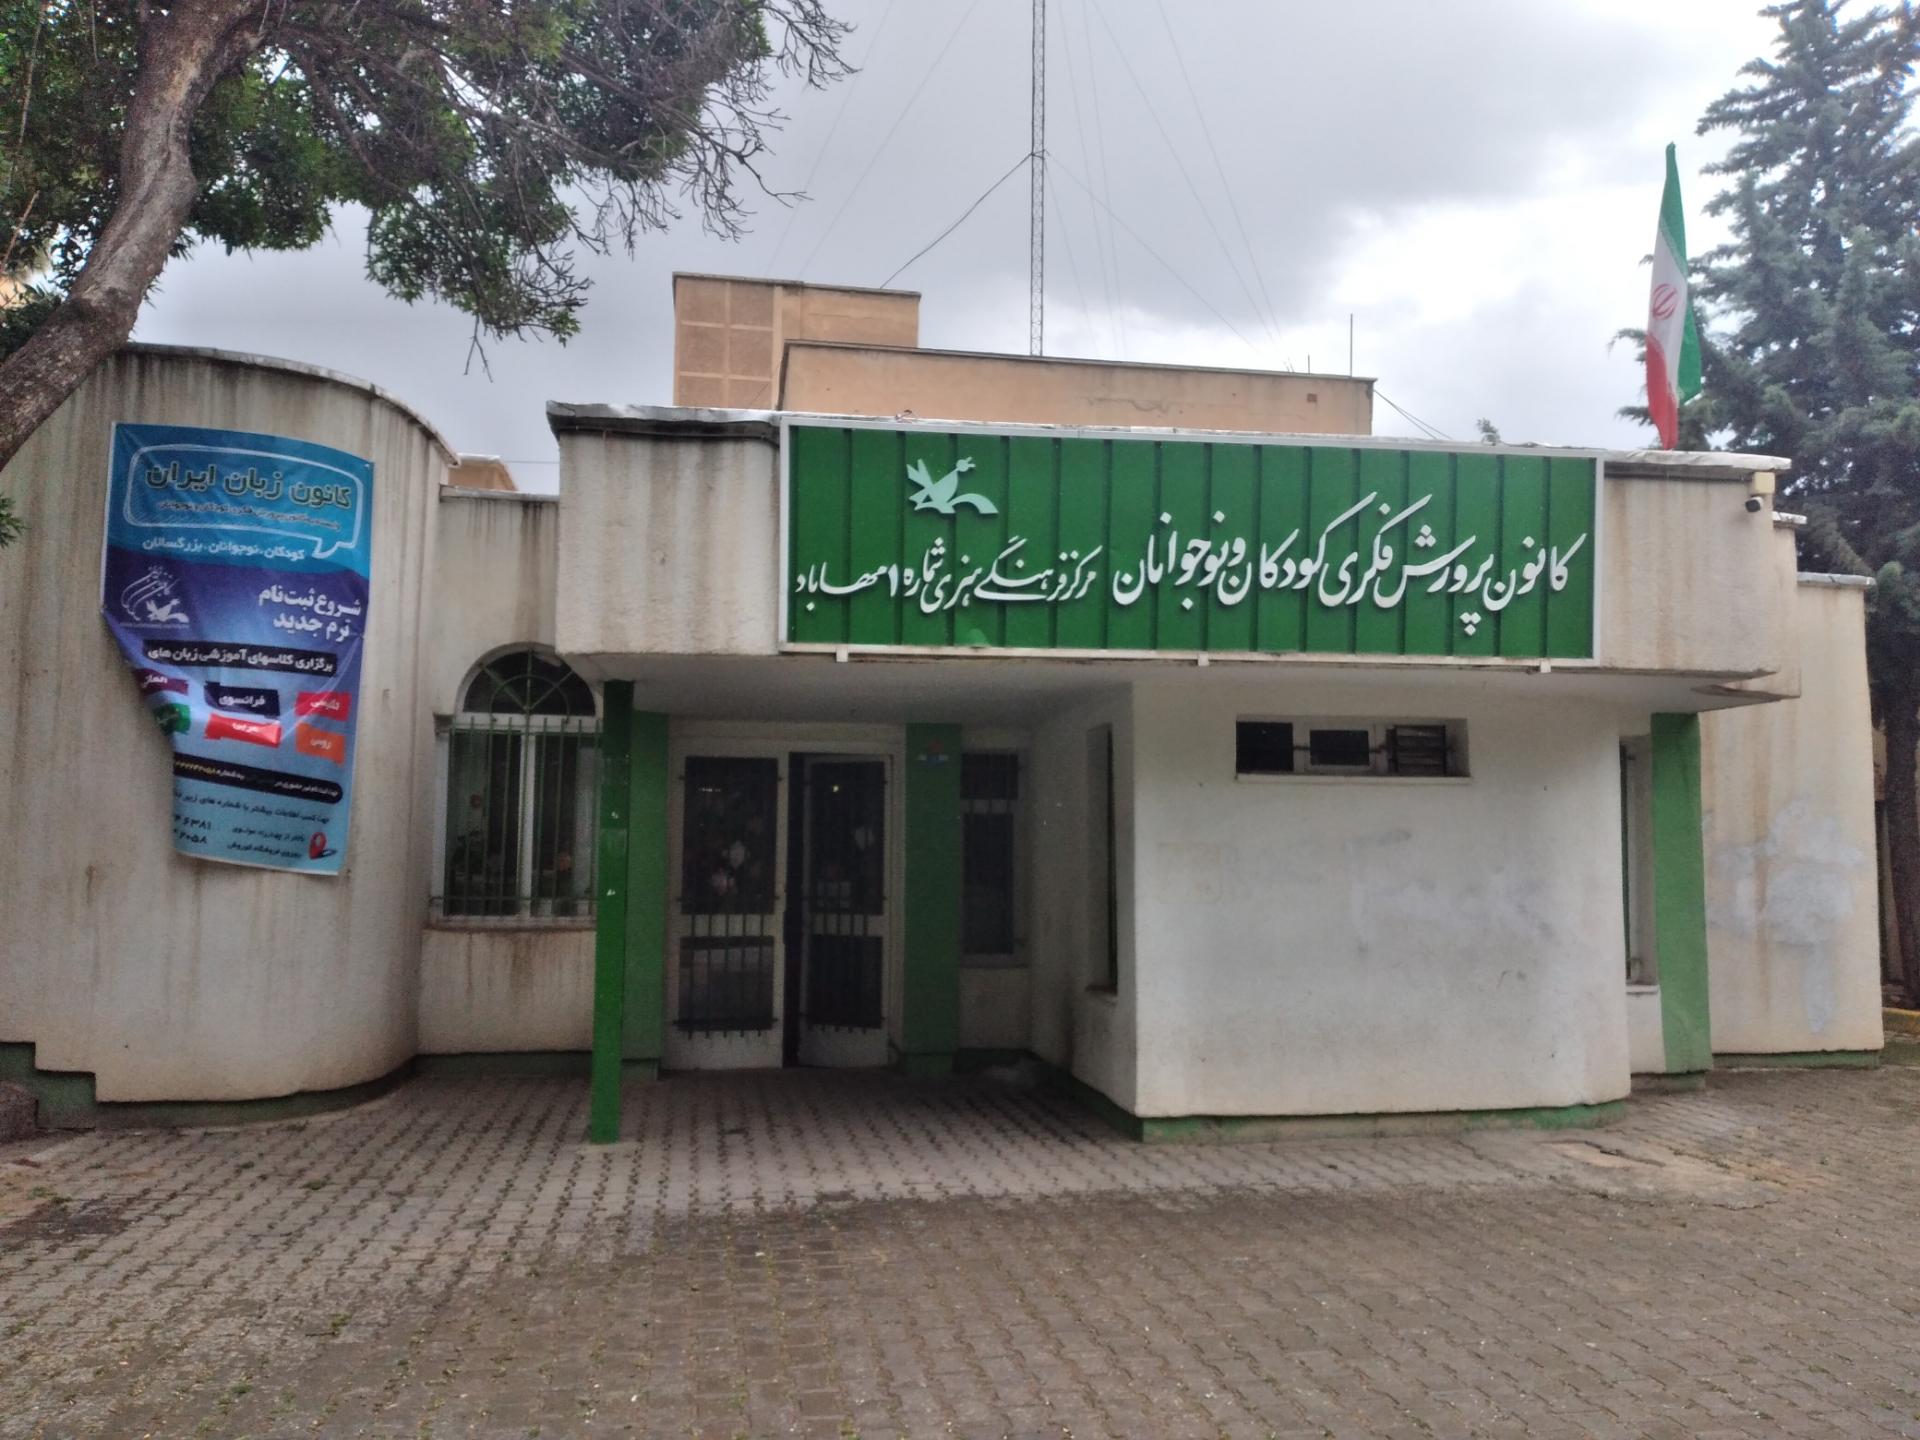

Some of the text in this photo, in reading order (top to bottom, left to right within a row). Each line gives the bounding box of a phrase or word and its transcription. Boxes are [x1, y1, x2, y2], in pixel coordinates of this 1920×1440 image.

[145, 461, 352, 508] کانون زبان ایران
[903, 537, 946, 597] شماره
[973, 535, 1068, 601] فرهنگی
[1059, 545, 1102, 601] مرکز
[1112, 510, 1230, 610] نوجوانان
[1217, 491, 1378, 606] کودکان
[1227, 537, 1246, 567] و
[1318, 494, 1433, 608] فکری
[1482, 533, 1587, 611] کانون
[313, 594, 361, 617] شروع
[796, 562, 888, 611] مهاباد
[920, 555, 982, 613] هنری
[1373, 525, 1494, 636] پرورش
[273, 612, 351, 642] ترم جدید
[295, 657, 334, 673] برگزاری
